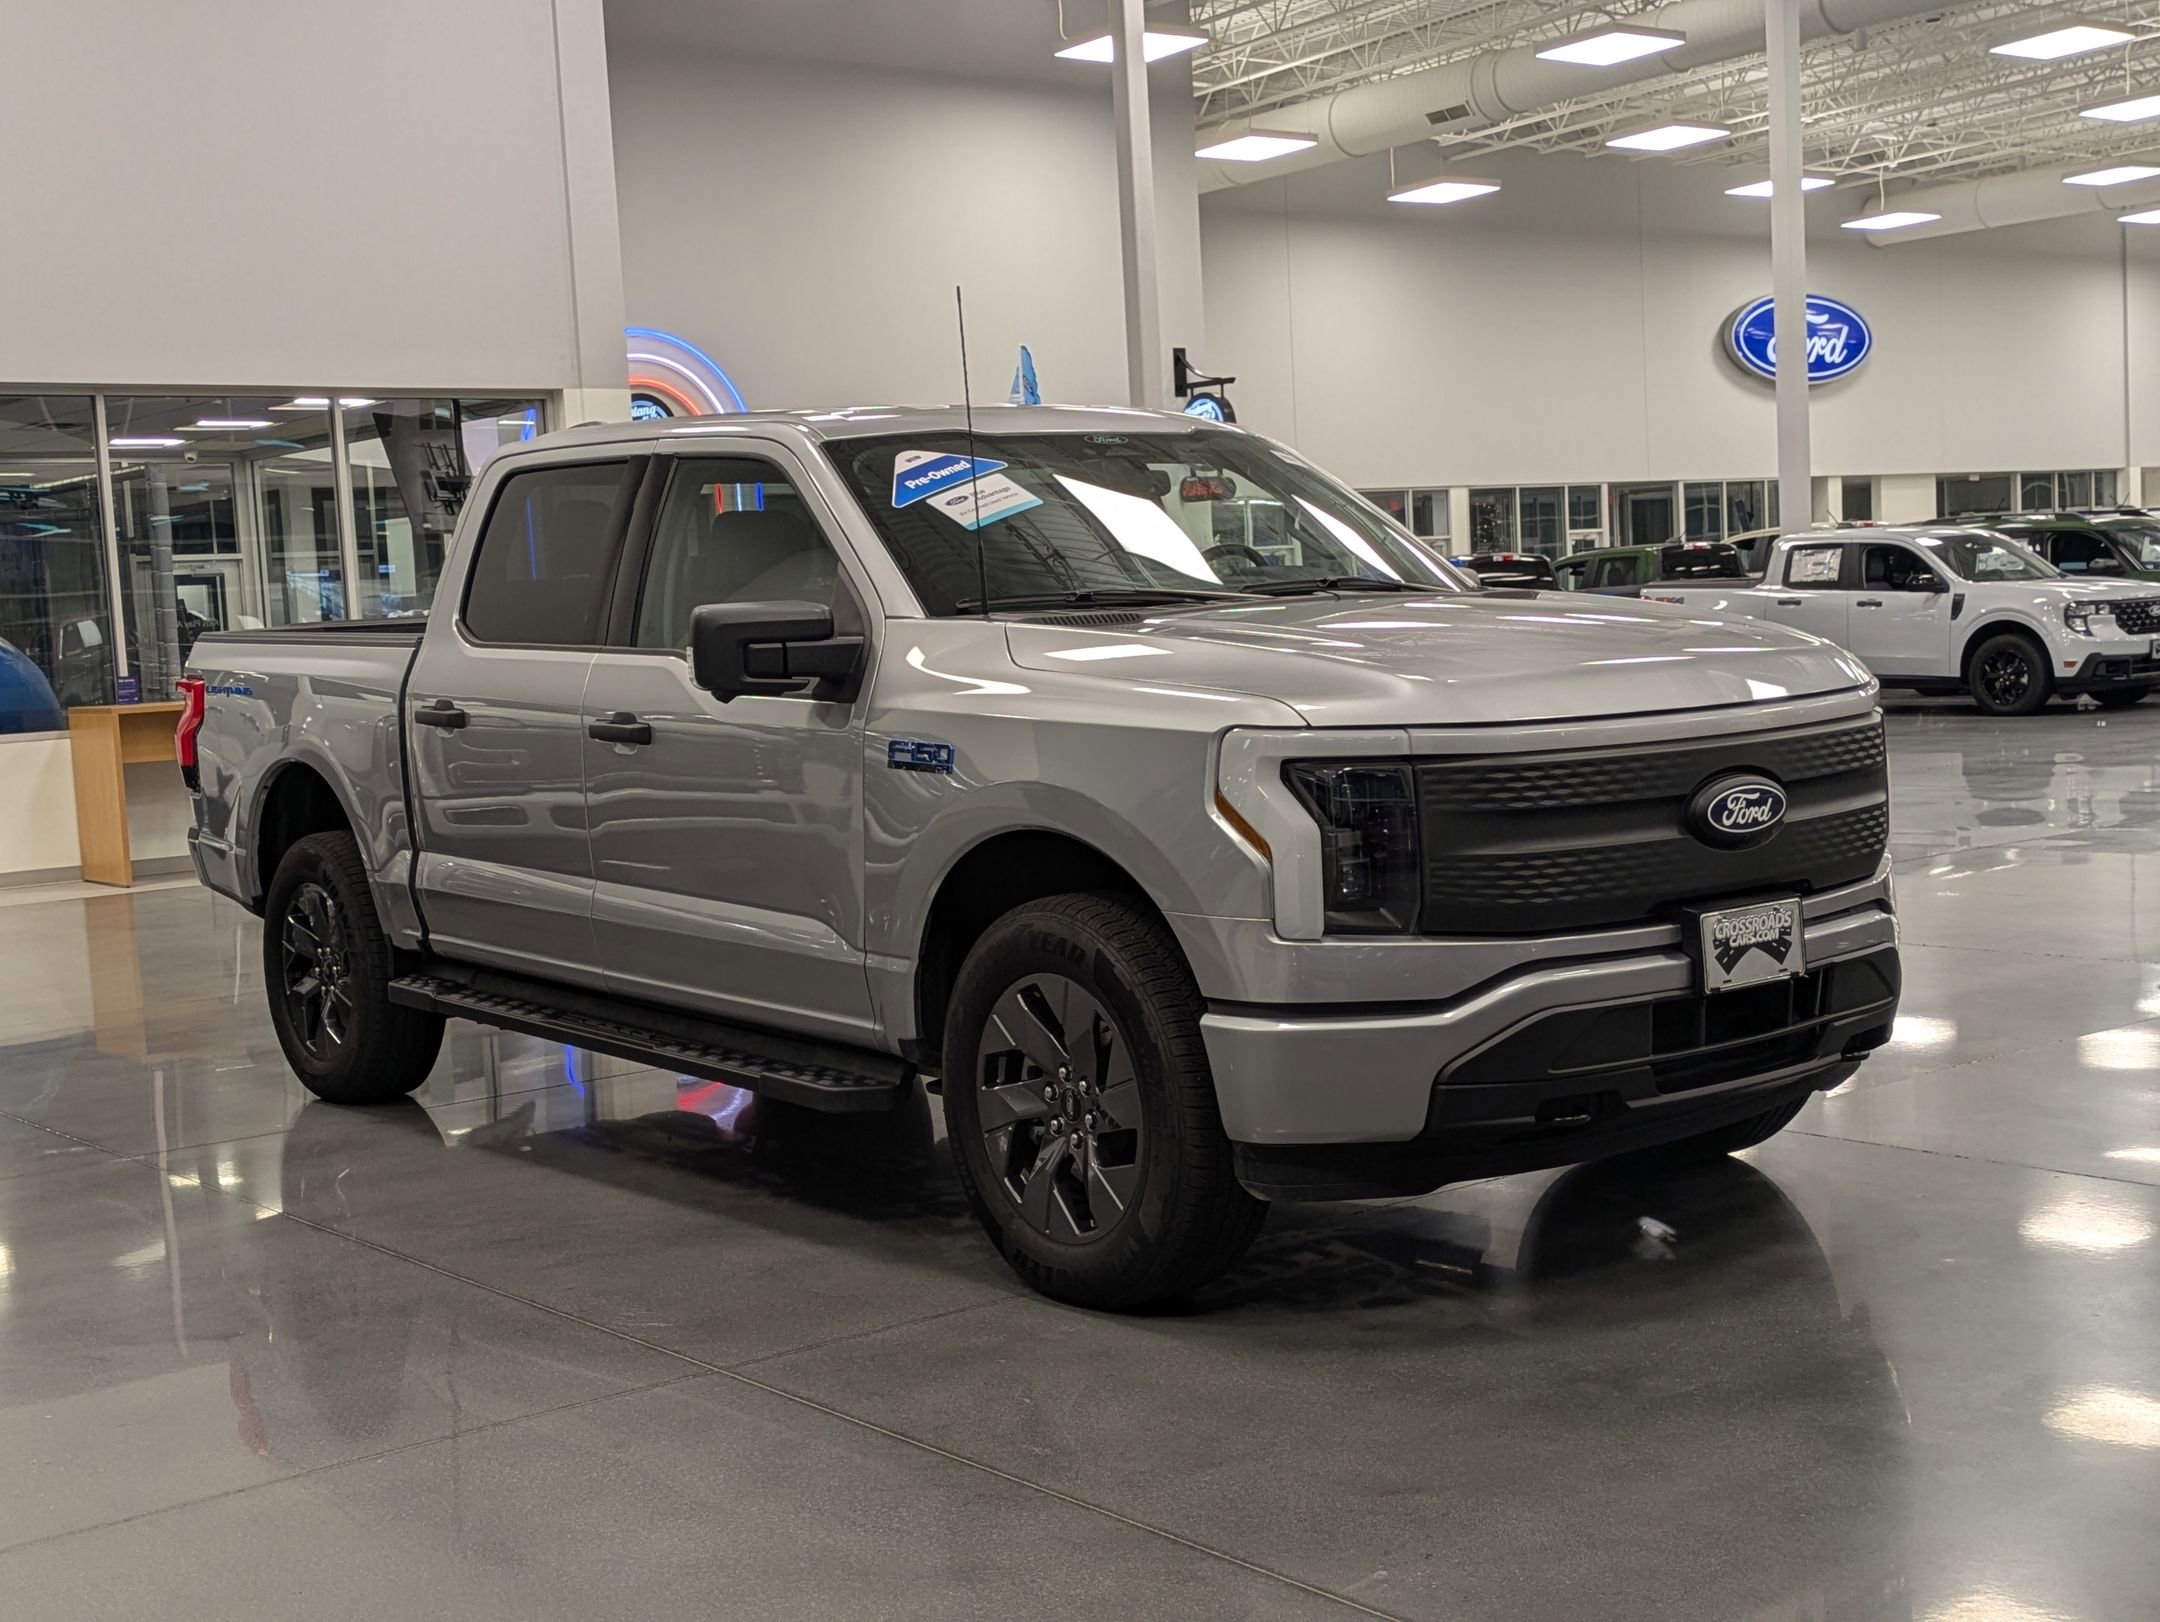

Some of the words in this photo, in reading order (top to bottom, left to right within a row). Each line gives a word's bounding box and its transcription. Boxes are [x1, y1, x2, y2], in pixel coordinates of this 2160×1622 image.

[904, 459, 972, 490] Pre-Owned
[1722, 791, 1773, 827] Ford
[1715, 909, 1793, 941] CROSSROADS
[1728, 927, 1780, 949] CARS.COM
